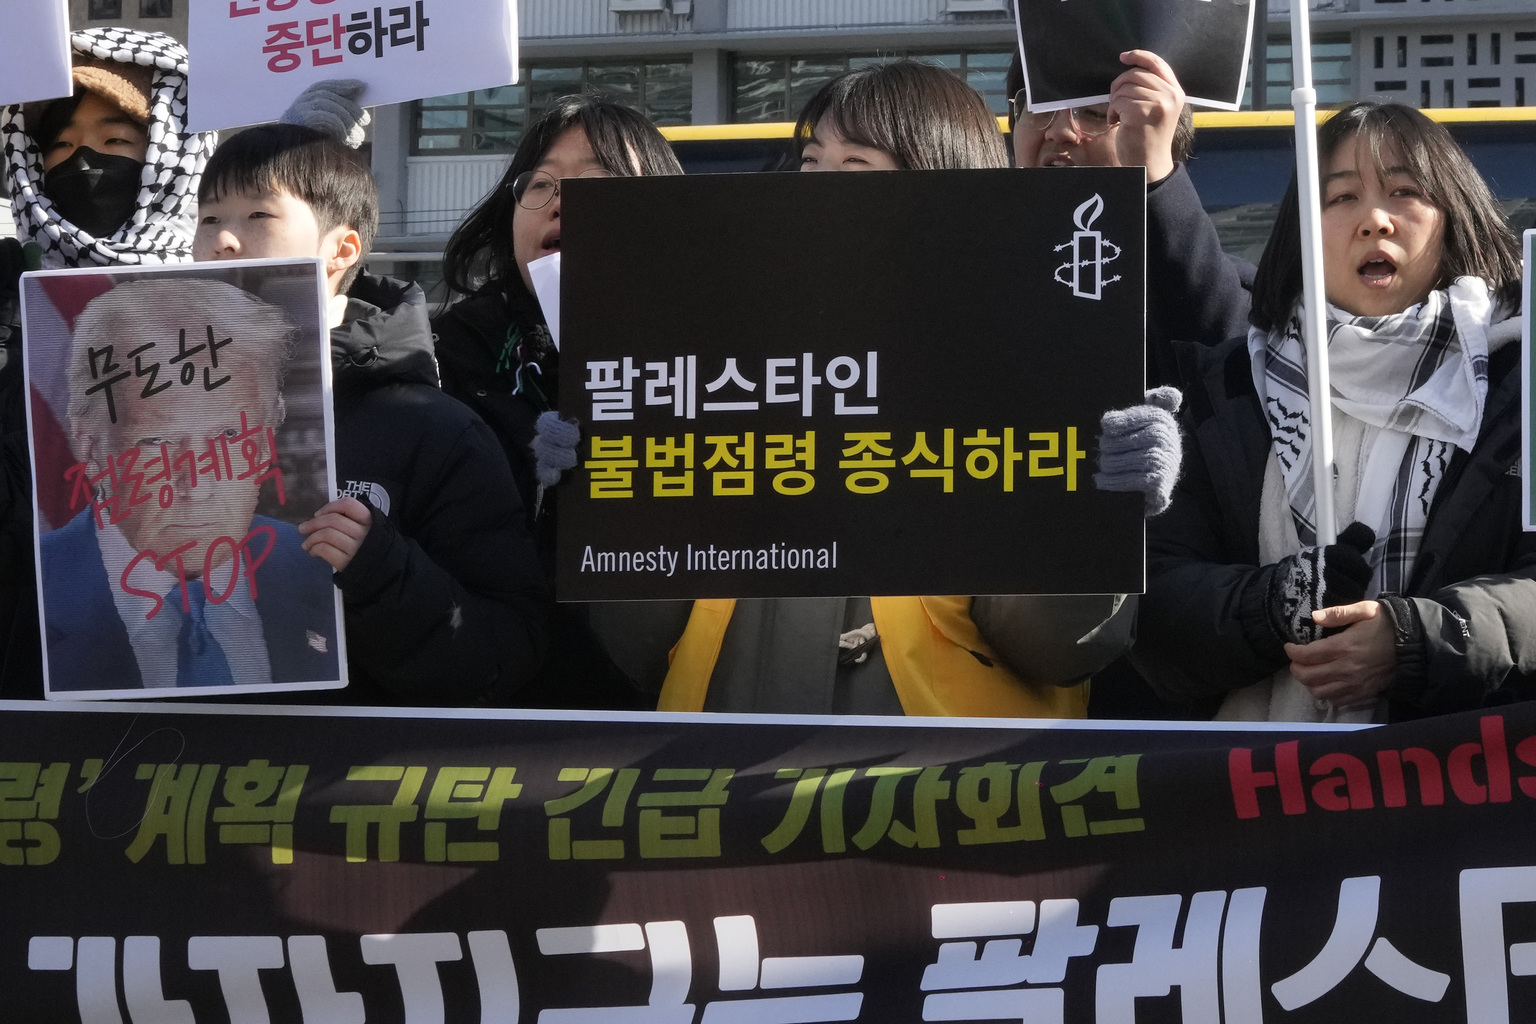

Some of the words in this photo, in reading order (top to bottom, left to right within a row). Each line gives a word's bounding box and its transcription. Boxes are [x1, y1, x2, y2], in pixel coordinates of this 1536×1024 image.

[262, 0, 430, 74] 중단하라
[84, 324, 234, 424] 무도한
[584, 351, 880, 421] 팔레스타인
[63, 410, 287, 531] 점령계획
[345, 480, 372, 493] THE
[584, 430, 817, 500] 불법점령
[838, 426, 1087, 495] 종식하라
[119, 524, 277, 621] STOP
[580, 544, 679, 577] Amnesty
[686, 541, 838, 572] International
[125, 759, 309, 865] 계획
[329, 765, 523, 864] 규탄
[544, 767, 734, 860] 긴급
[760, 753, 1145, 854] 기자회견
